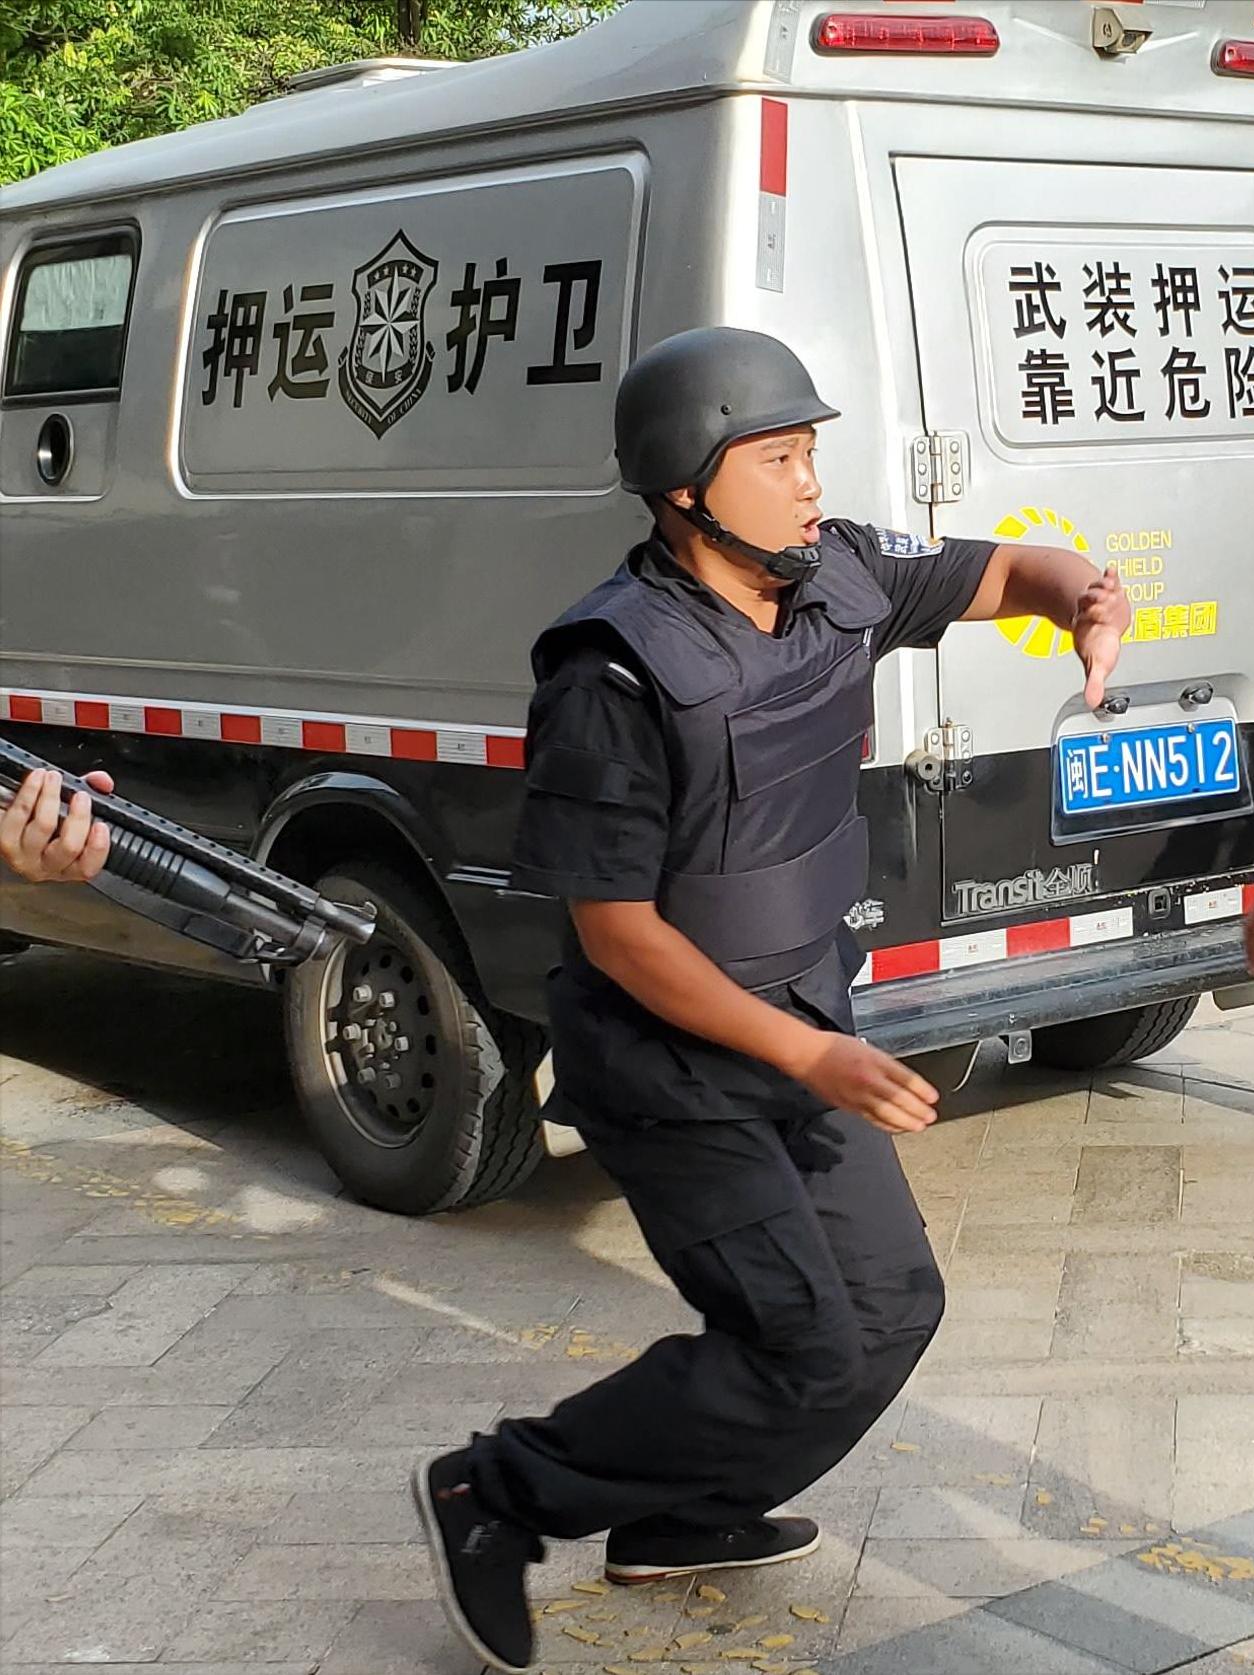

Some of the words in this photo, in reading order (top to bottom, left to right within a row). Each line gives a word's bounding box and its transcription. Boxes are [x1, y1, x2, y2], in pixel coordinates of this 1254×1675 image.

[201, 283, 336, 409] 押运
[447, 256, 603, 396] 护卫
[1105, 528, 1173, 553] GOLDEN
[1120, 581, 1165, 603] ROUP
